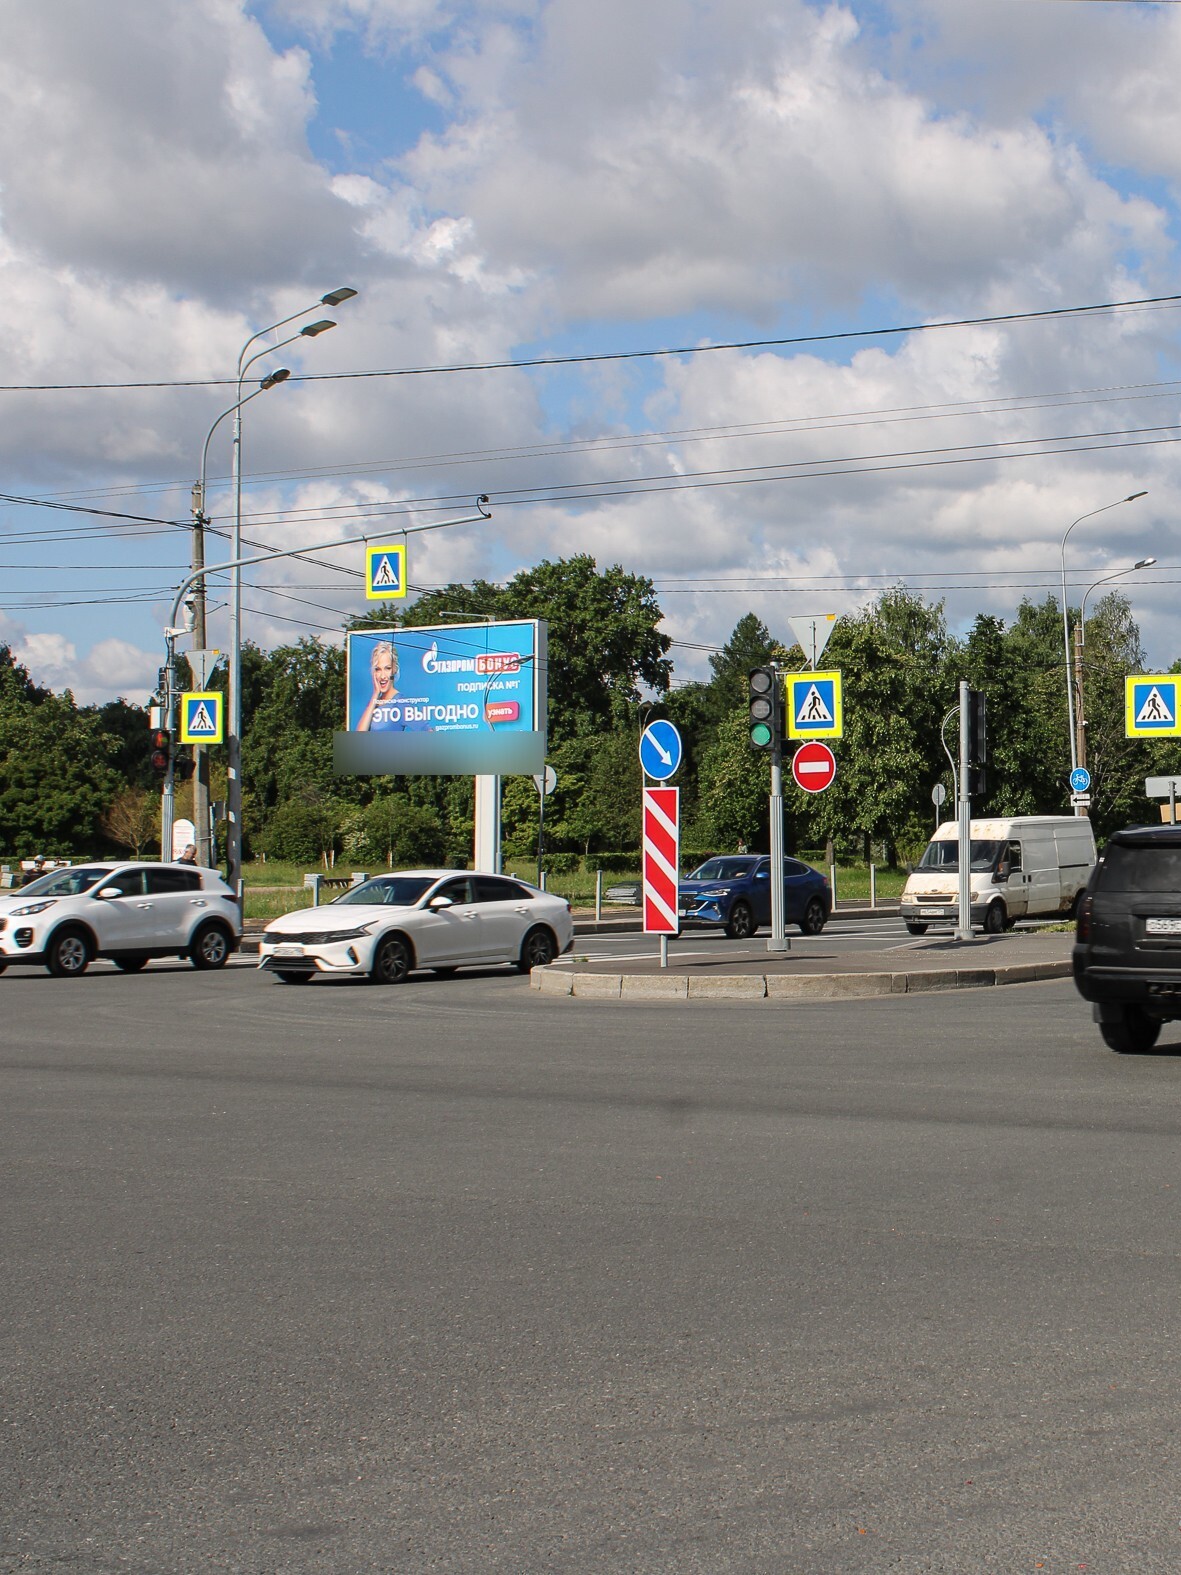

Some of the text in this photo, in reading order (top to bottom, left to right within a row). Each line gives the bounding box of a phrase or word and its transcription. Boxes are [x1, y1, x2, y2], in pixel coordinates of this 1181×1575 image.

[479, 657, 517, 671] БОНУС
[457, 681, 504, 693] ПОДПИСКА
[372, 704, 479, 723] ЭТО ВЫГОДНО
[487, 707, 513, 719] узнать
[435, 723, 479, 732] gazprombonus.ru
